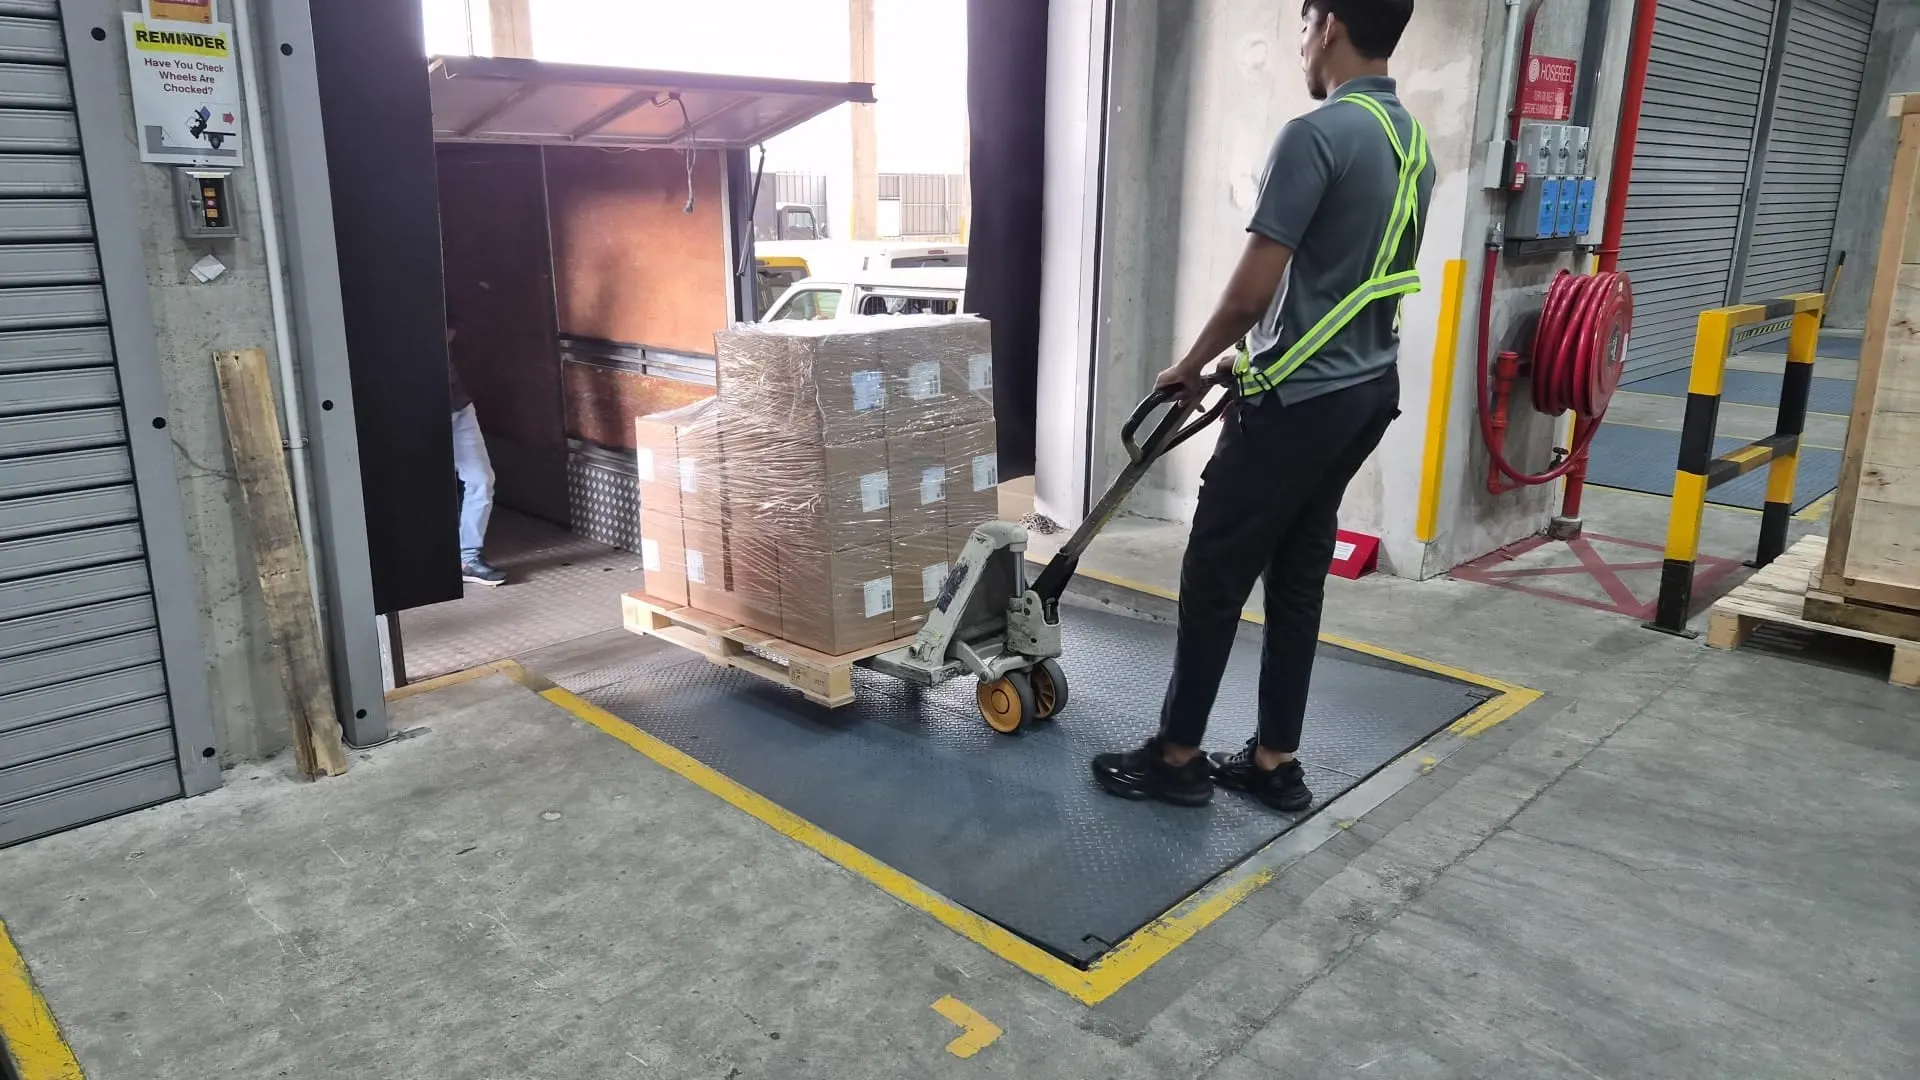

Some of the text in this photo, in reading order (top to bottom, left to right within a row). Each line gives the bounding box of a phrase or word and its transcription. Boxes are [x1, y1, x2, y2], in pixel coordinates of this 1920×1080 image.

[135, 29, 226, 50] REMINDER
[144, 57, 224, 73] Have You Check
[158, 70, 215, 83] Wheels Are
[163, 83, 214, 95] Chocked?
